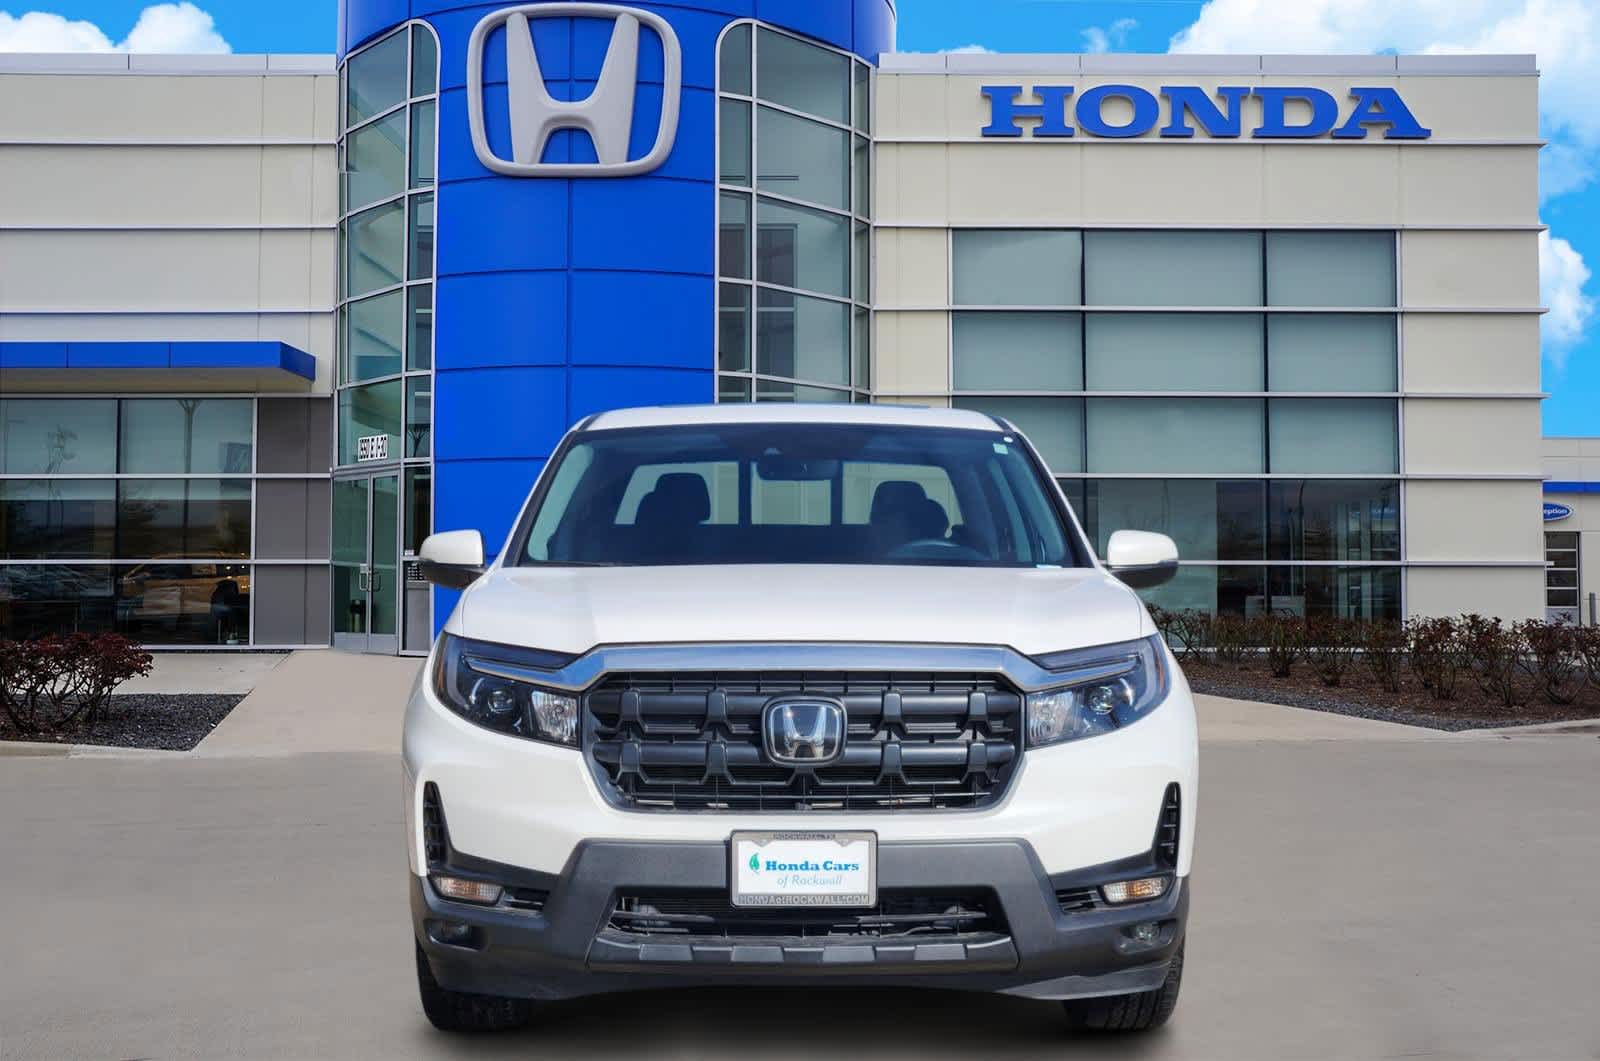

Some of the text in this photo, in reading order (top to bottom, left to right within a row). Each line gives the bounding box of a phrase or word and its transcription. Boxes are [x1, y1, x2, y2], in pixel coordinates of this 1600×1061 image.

[981, 85, 1431, 139] HONDA
[765, 860, 859, 871] Honda Cars
[777, 875, 842, 888] of Rockwall
